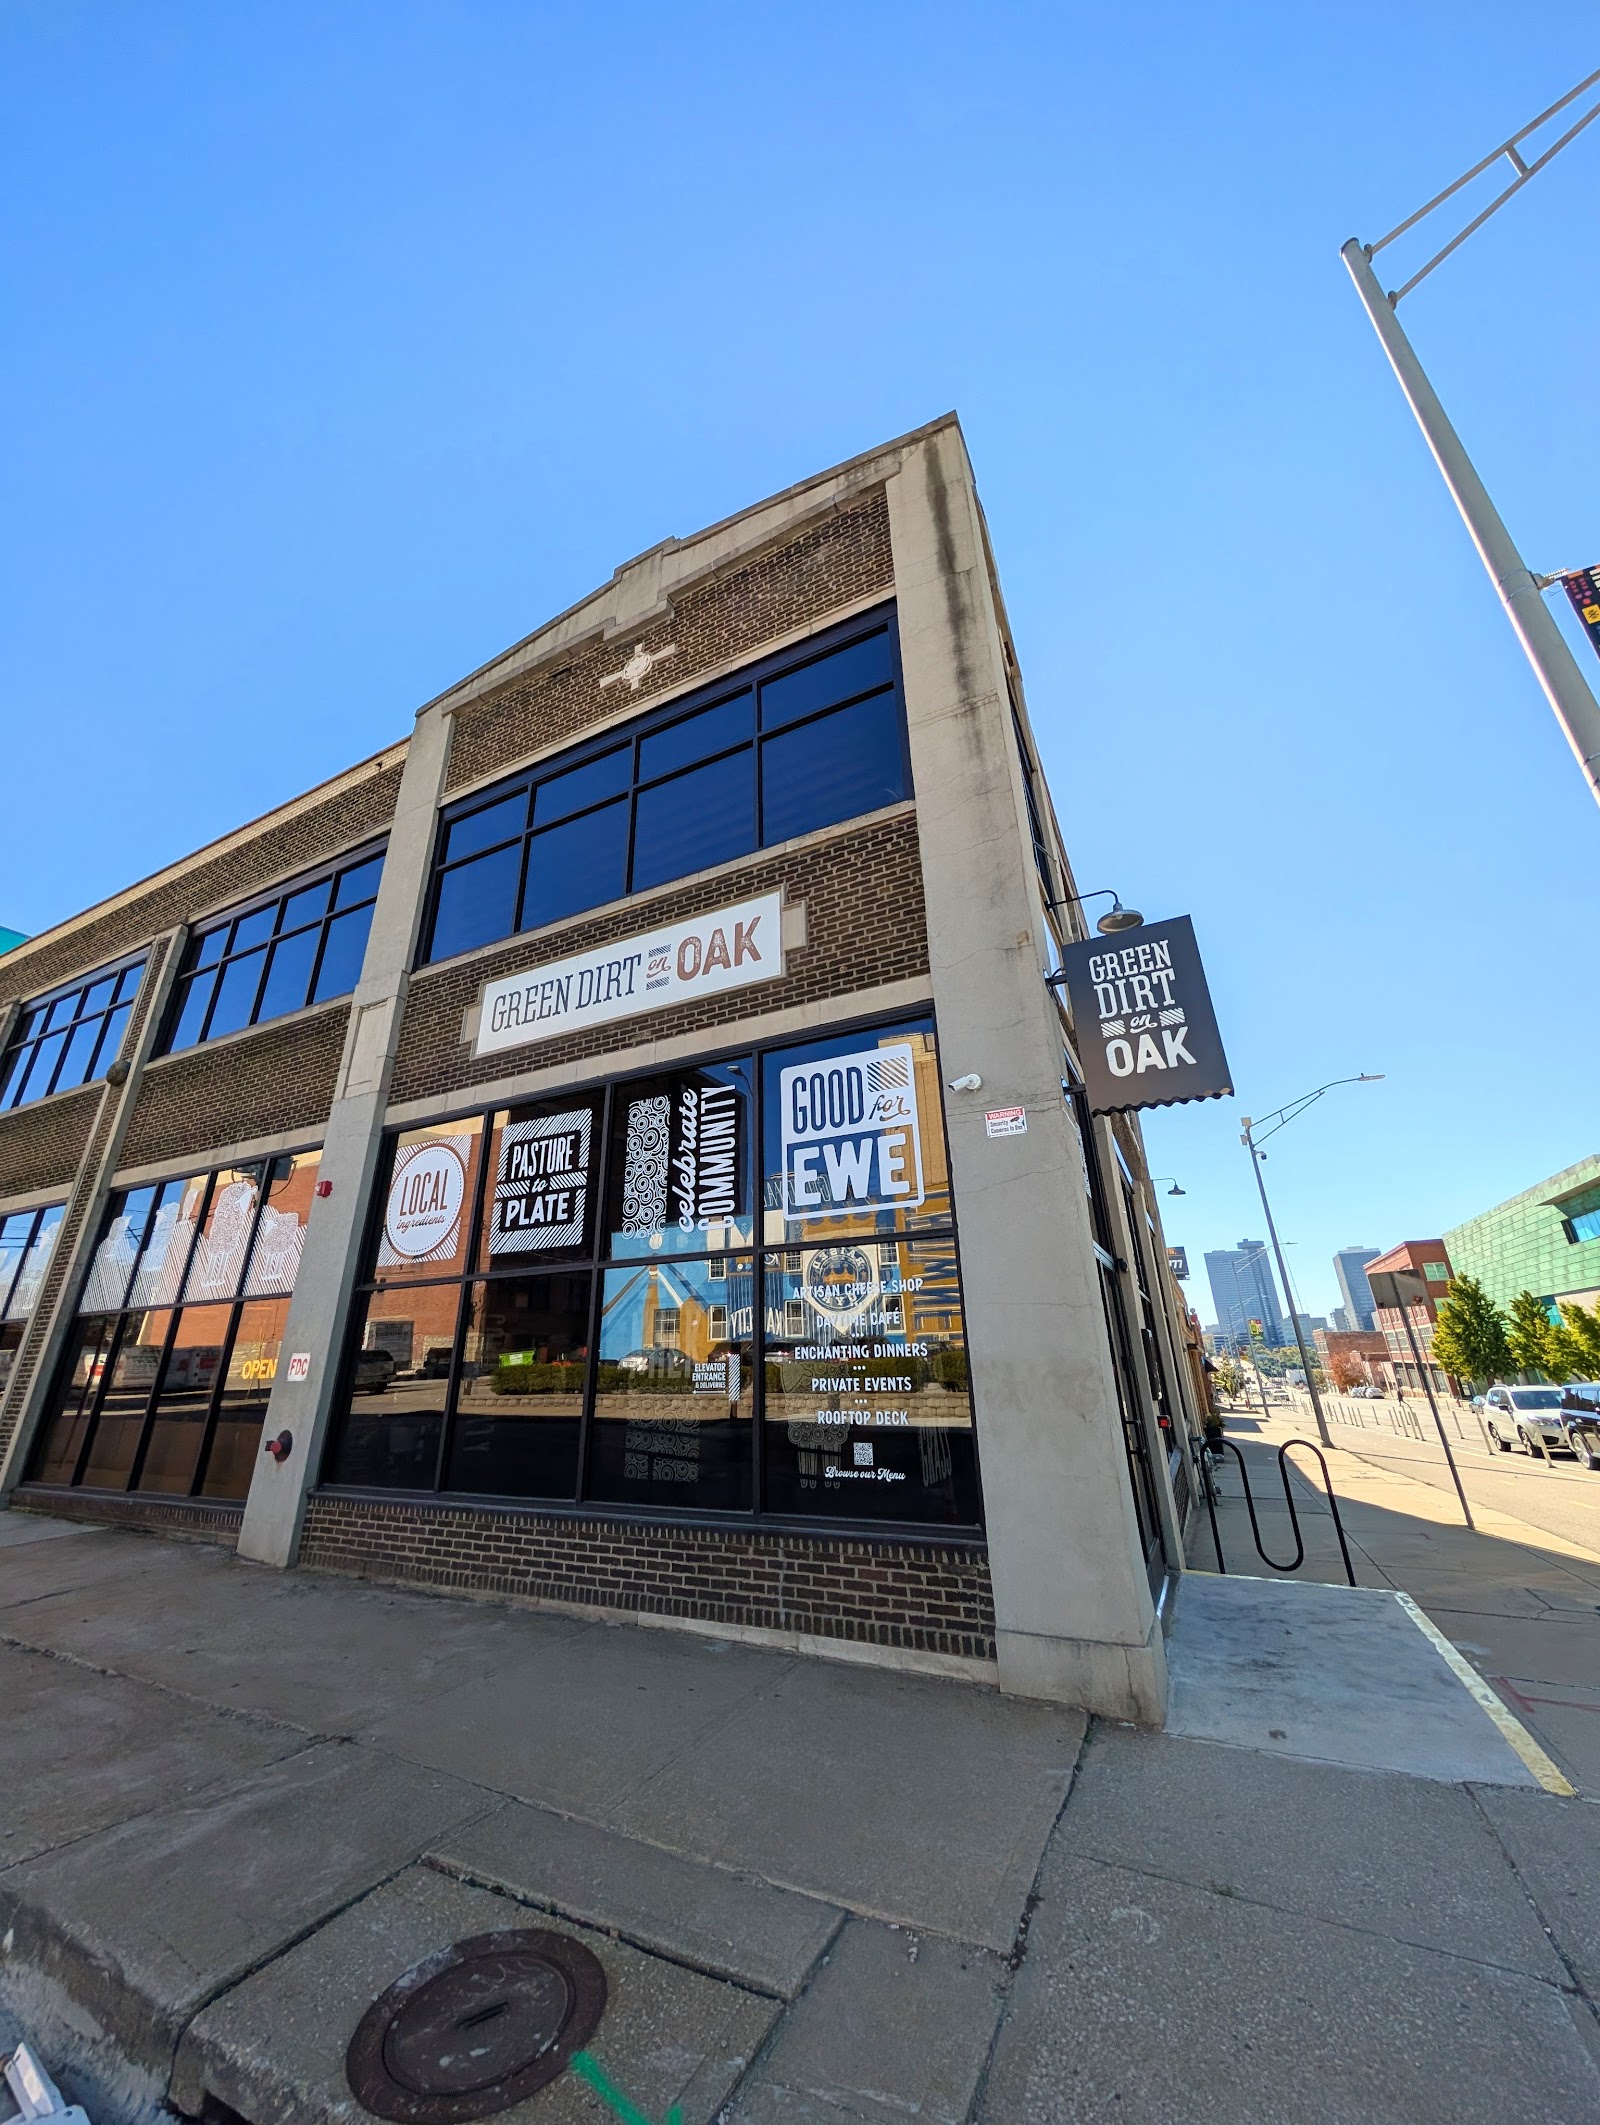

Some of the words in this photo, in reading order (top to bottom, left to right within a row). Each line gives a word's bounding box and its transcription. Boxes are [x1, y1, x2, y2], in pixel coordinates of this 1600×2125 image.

[1088, 939, 1172, 983] GREEN
[491, 974, 573, 1033] GREEN
[575, 953, 642, 1010] DIRT
[646, 955, 672, 979] on
[676, 916, 762, 981] OAK
[1093, 968, 1176, 1020] DIRT
[1130, 1014, 1157, 1034] on
[1105, 1026, 1197, 1077] OAK
[791, 1066, 863, 1134] GOOD
[869, 1093, 911, 1122] for
[988, 1109, 1022, 1120] WARNING
[510, 1135, 575, 1179] PASTURE
[672, 1088, 698, 1233] celebrate
[698, 1085, 736, 1231] COMMUNITY
[794, 1132, 910, 1206] EWE
[399, 1169, 448, 1217] LOCAL
[531, 1178, 548, 1193] to
[505, 1192, 570, 1228] PLATE
[396, 1214, 446, 1234] ingredients
[793, 1284, 840, 1299] ARTISAN
[891, 1278, 923, 1293] SHOP
[870, 1307, 900, 1326] CAFÉ
[794, 1345, 870, 1360] ENCHANTING
[875, 1342, 928, 1358] DINNERS
[242, 1359, 278, 1379] OPEN
[289, 1358, 308, 1376] FDC
[692, 1372, 726, 1382] ENTRANCE
[694, 1363, 726, 1372] ELEVATOR
[811, 1377, 860, 1392] PRIVATE
[864, 1376, 912, 1391] EVENTS
[817, 1410, 871, 1426] ROOFTOP
[875, 1410, 909, 1425] DECK
[825, 1466, 859, 1479] Browse
[860, 1470, 876, 1478] our
[877, 1467, 906, 1482] Menu
